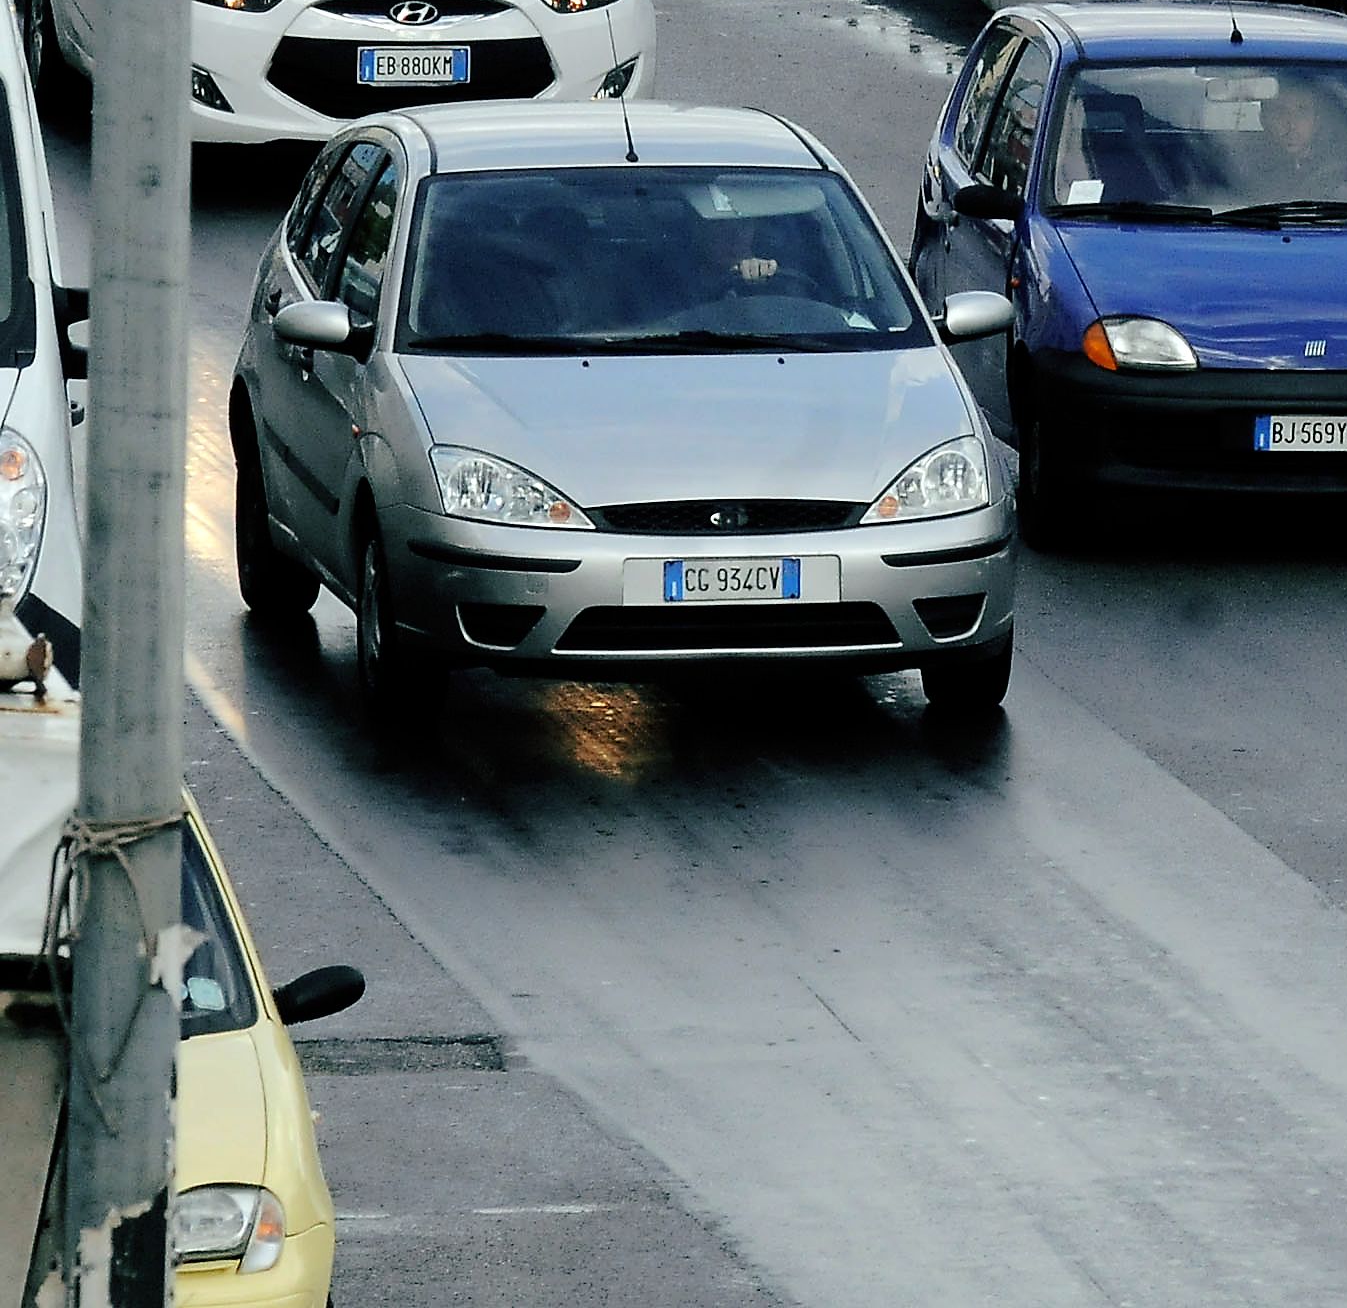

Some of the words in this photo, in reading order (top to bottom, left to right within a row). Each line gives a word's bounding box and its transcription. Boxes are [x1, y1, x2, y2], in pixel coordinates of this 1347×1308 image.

[376, 56, 396, 76] EB
[401, 56, 453, 76] 880KM
[1272, 421, 1296, 444] BJ
[685, 568, 709, 592] CG
[716, 566, 780, 592] 934CV
